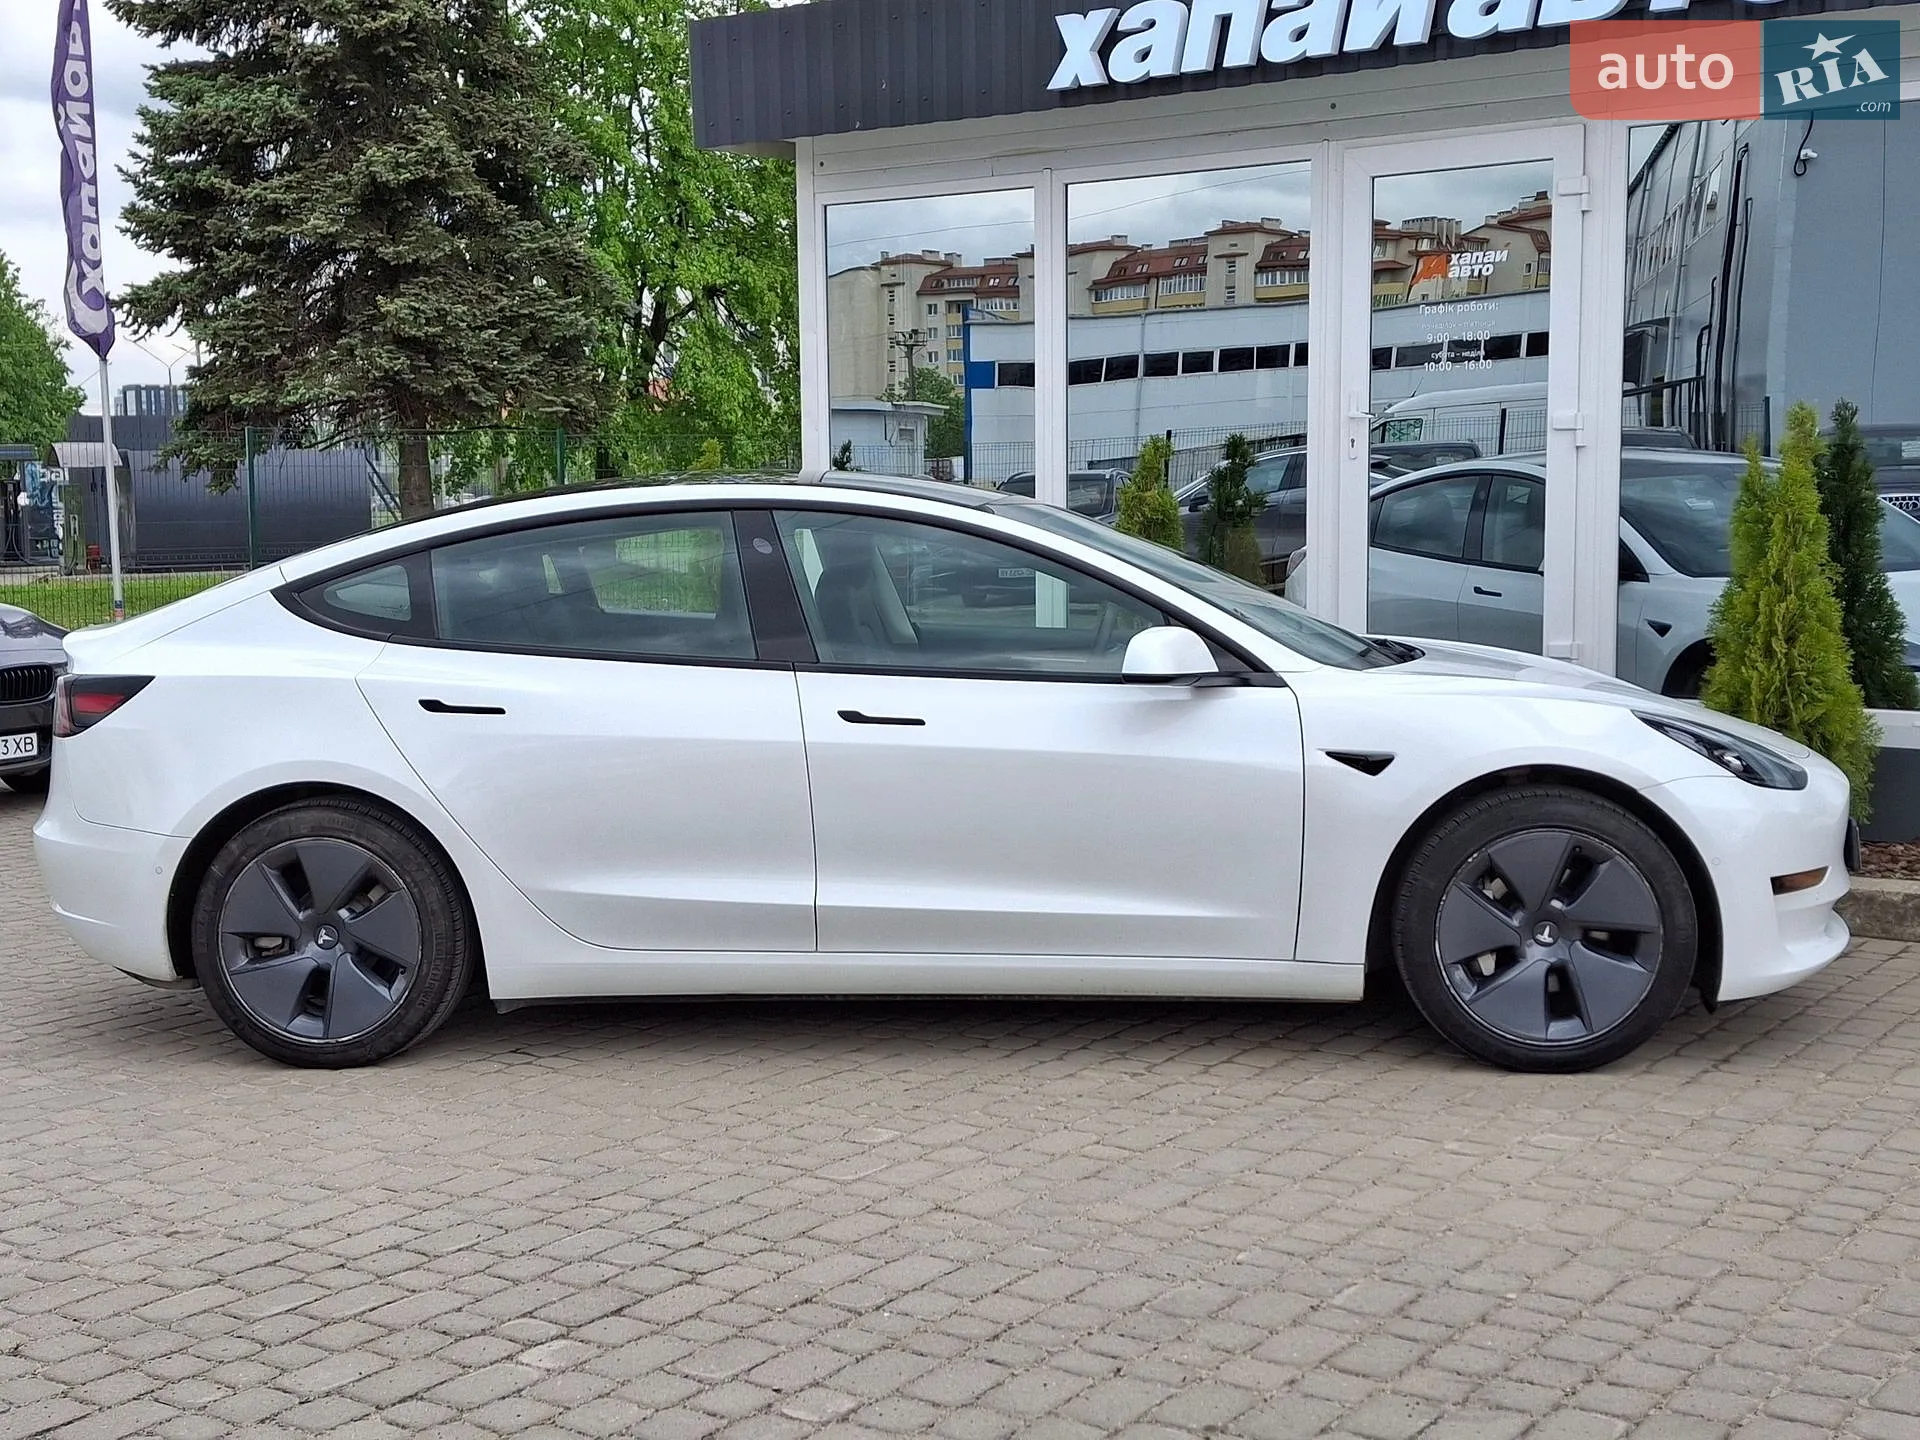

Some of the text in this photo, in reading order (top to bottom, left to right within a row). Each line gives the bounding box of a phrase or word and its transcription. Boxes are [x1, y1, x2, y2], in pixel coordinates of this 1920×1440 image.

[1448, 263, 1494, 278] авто
[1426, 332, 1450, 343] 9:00
[1462, 330, 1491, 342] 18:00
[1423, 361, 1452, 372] 10:00
[1463, 359, 1493, 371] 16:00
[13, 736, 34, 754] XB
